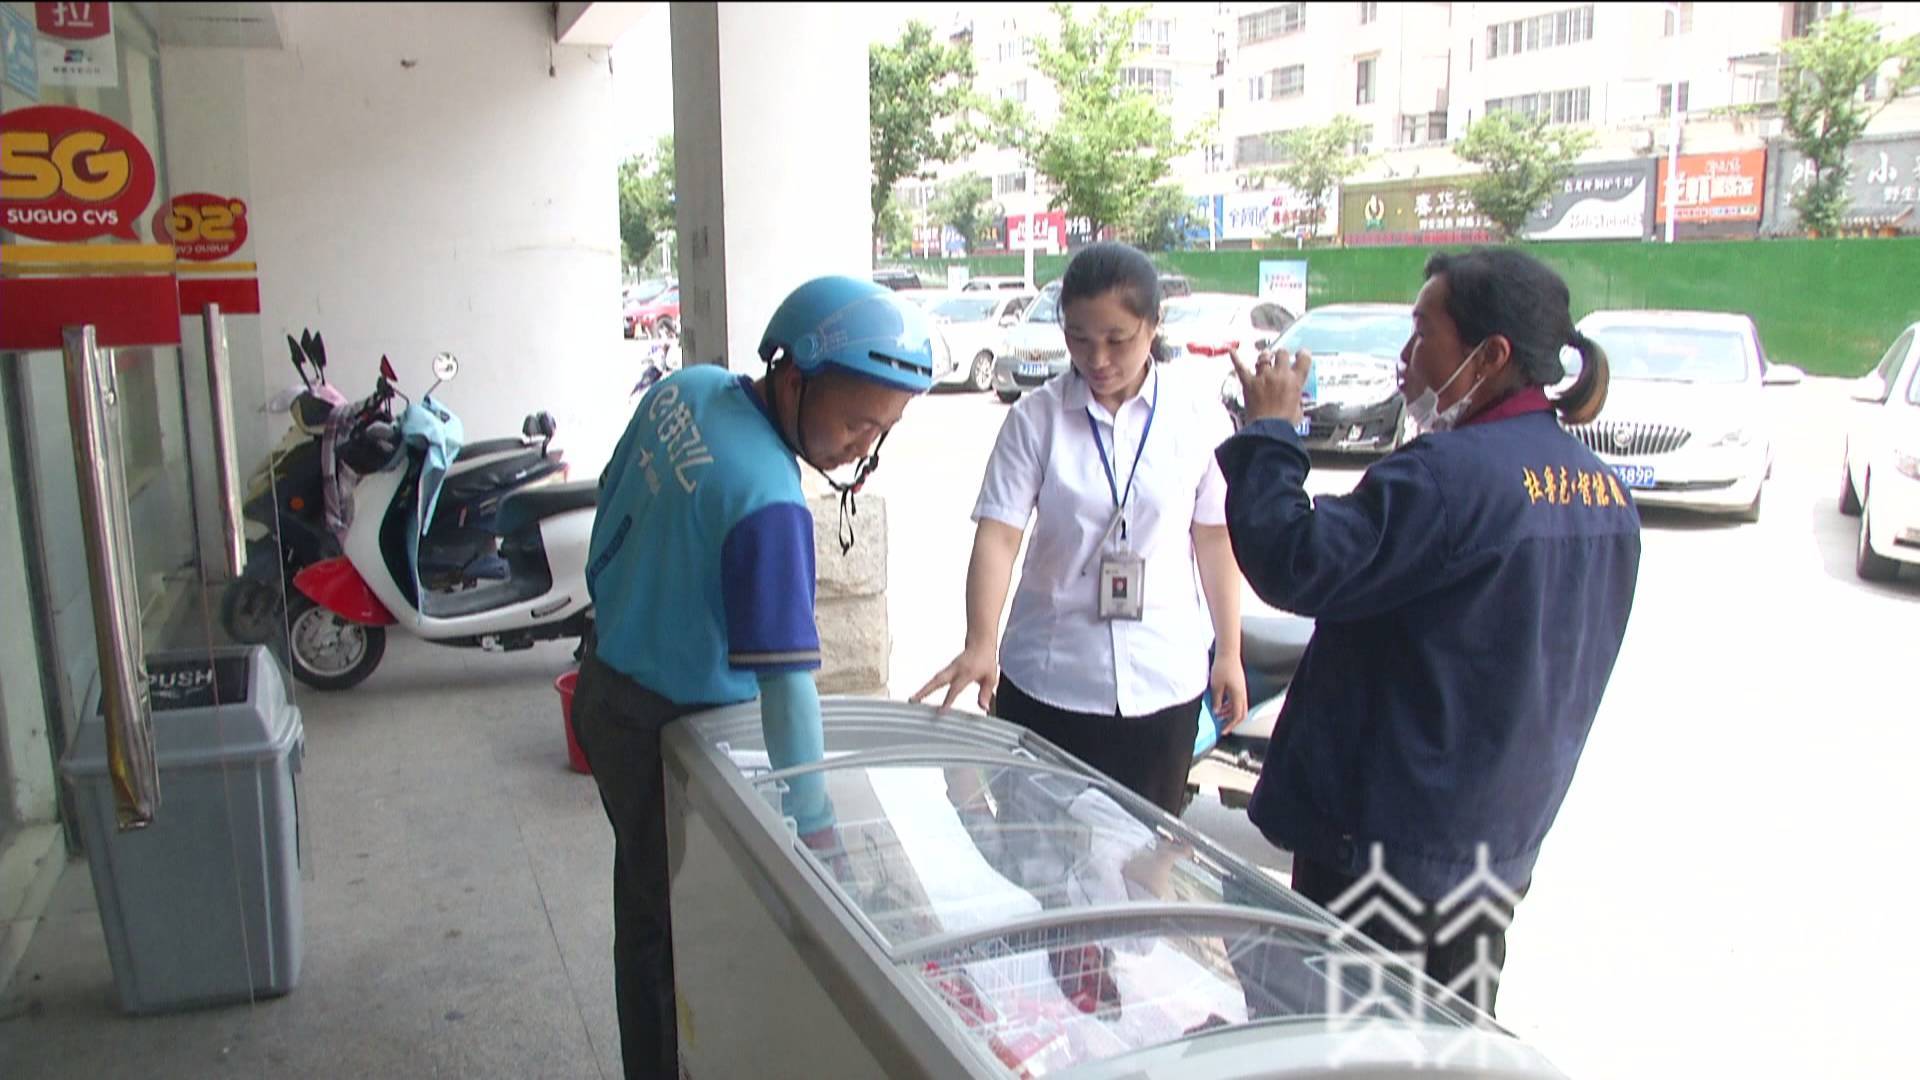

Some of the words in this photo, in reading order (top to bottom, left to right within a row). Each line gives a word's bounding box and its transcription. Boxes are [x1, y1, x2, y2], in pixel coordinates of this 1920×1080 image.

[7, 209, 77, 224] SUGUO
[83, 210, 119, 224] CVS
[148, 669, 213, 689] PUSH
